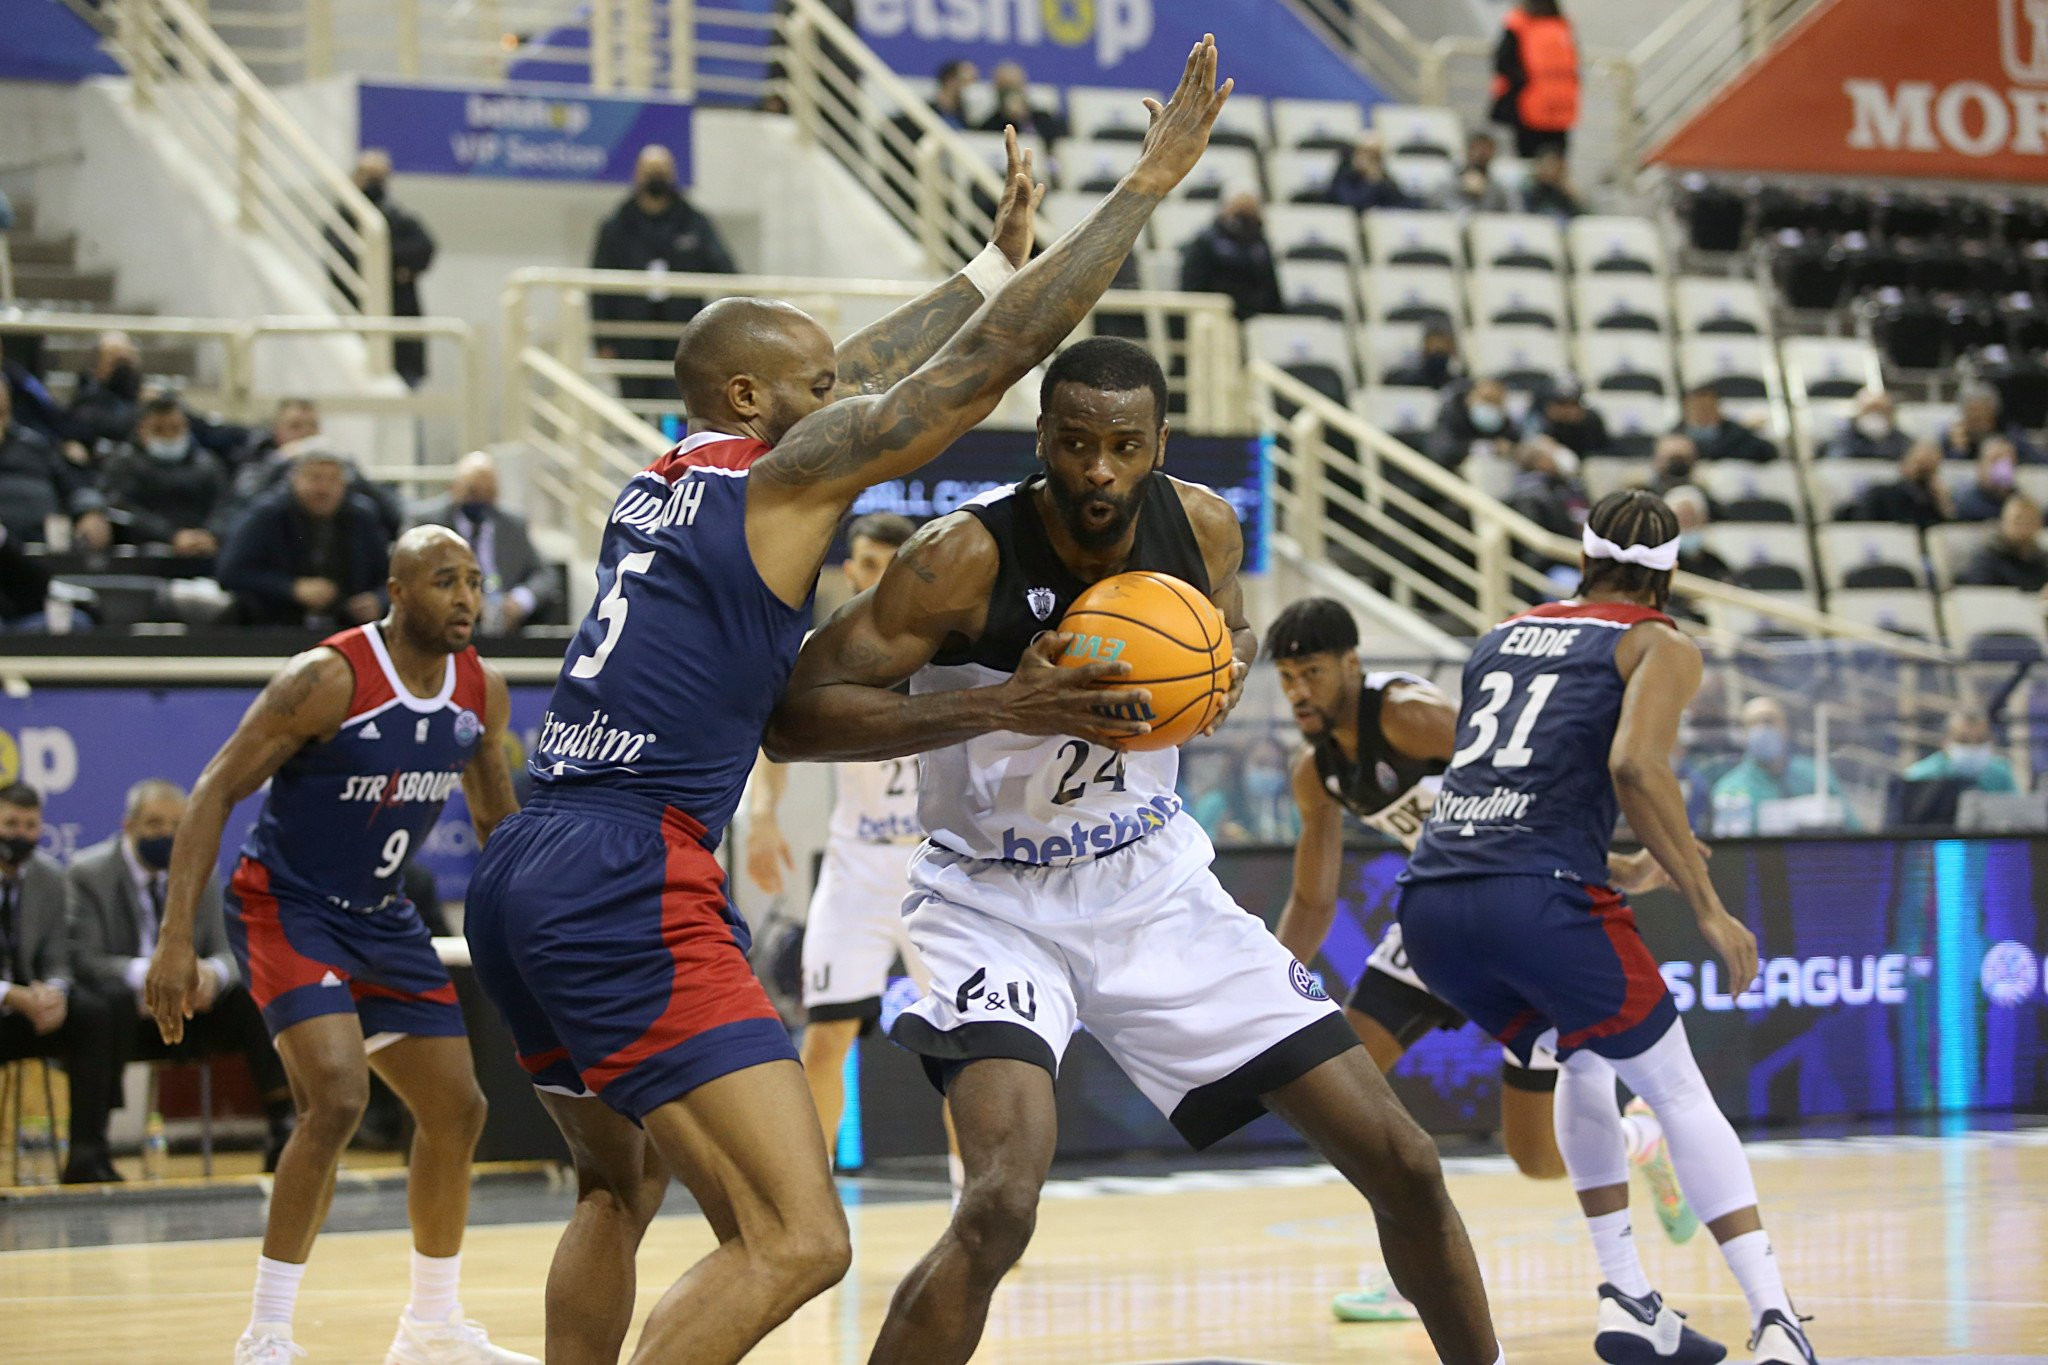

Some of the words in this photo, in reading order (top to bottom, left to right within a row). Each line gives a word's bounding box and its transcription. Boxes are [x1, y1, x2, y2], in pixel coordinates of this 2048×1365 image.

[569, 550, 656, 679] 5
[1499, 626, 1582, 658] EDDIE
[1451, 670, 1560, 770] 31
[1051, 739, 1127, 805] 24
[373, 828, 410, 878] 9
